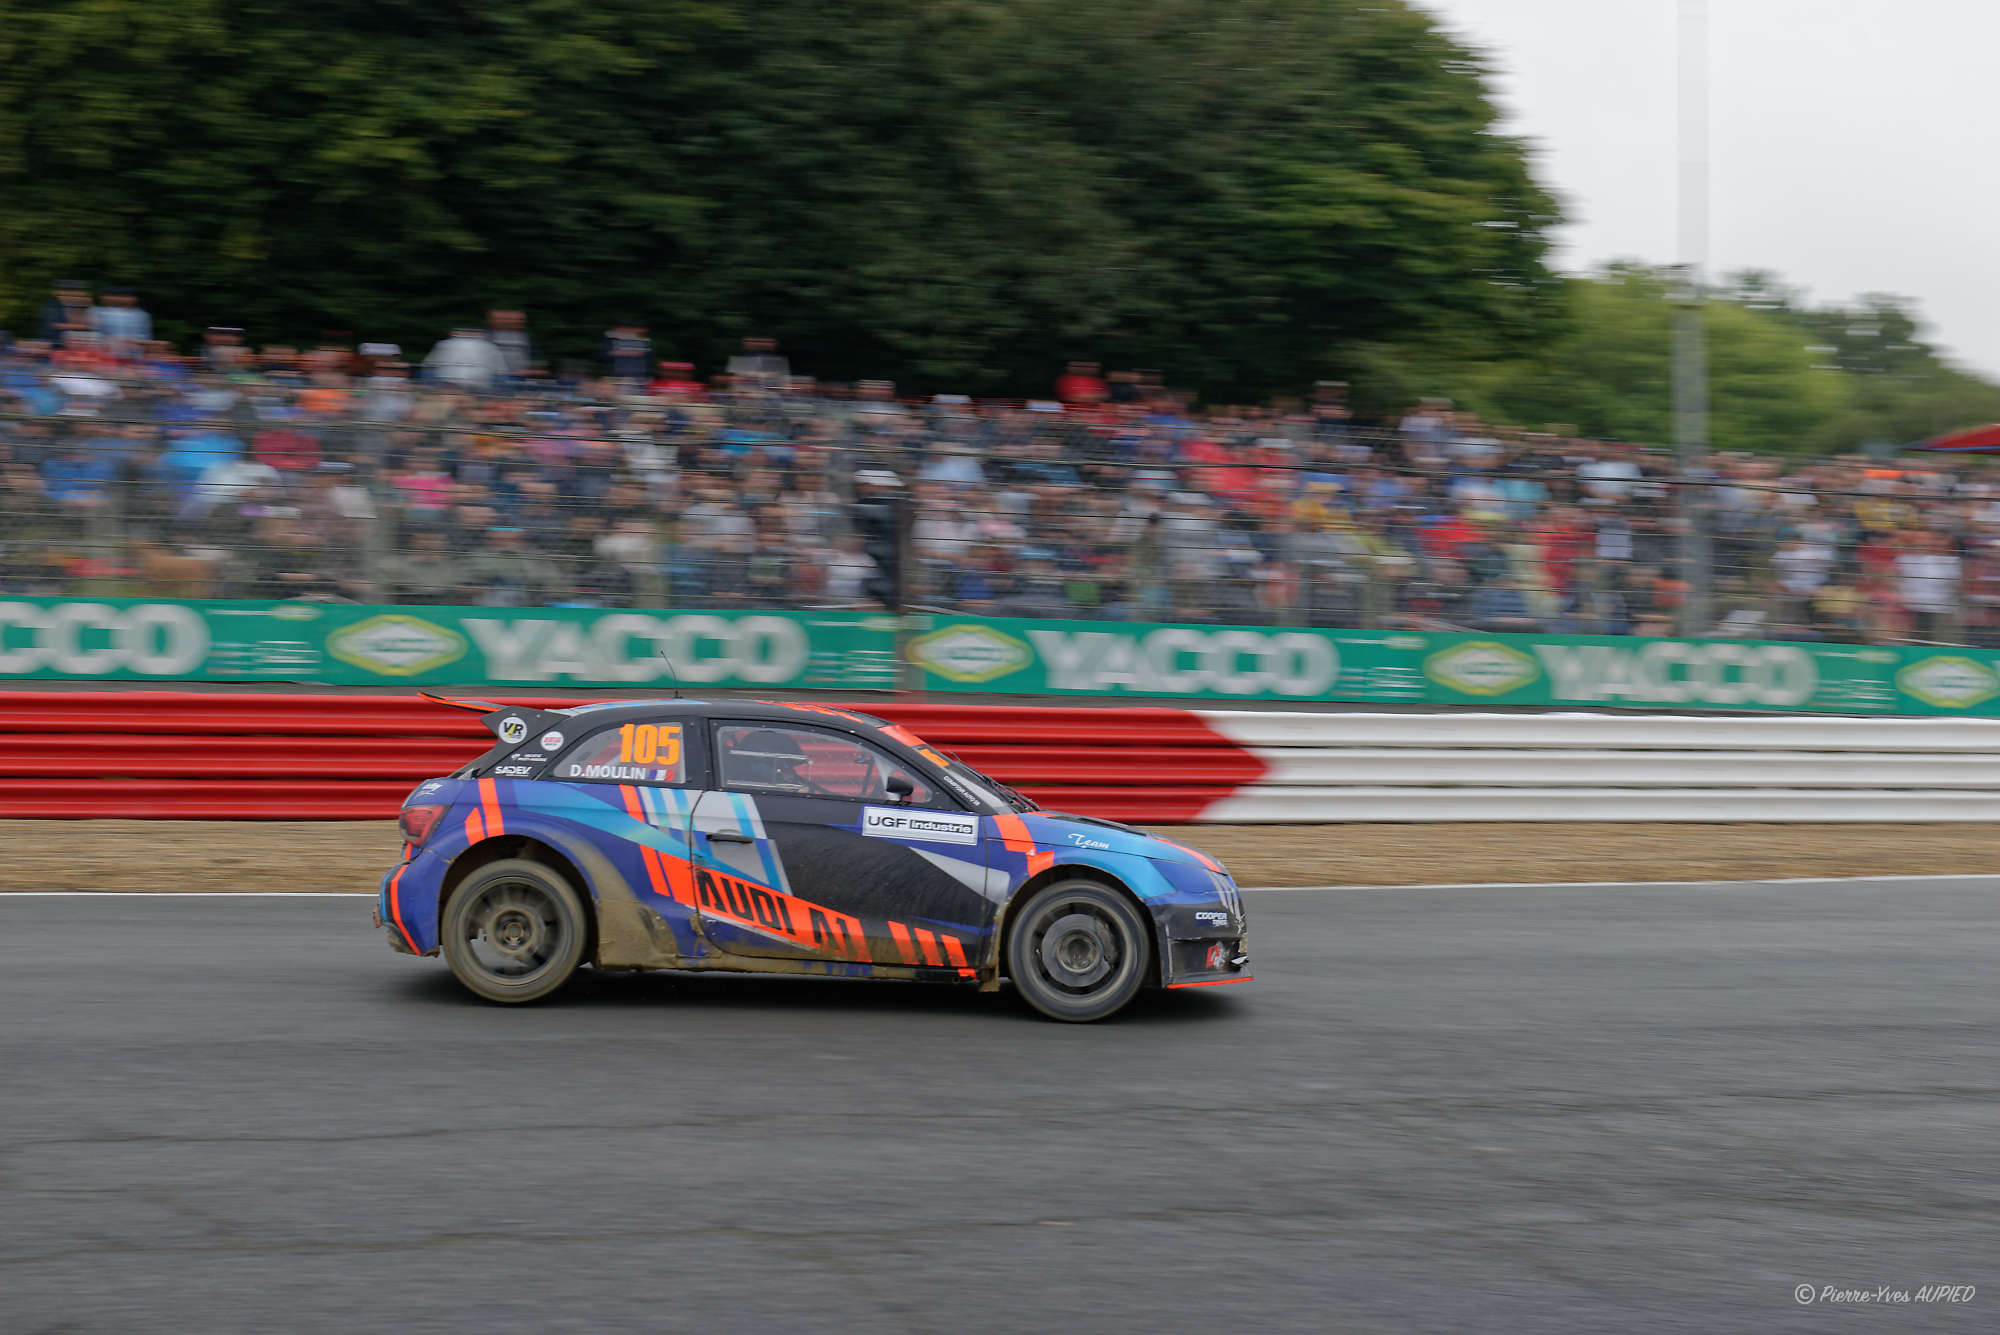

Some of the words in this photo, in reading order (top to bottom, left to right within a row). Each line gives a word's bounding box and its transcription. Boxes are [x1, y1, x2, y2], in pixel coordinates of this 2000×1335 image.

[459, 613, 810, 683] YACCO
[1025, 628, 1340, 697] YACCO
[1533, 641, 1817, 705] YACCO
[619, 723, 681, 765] 105
[495, 766, 532, 775] SADEV
[570, 764, 647, 780] D.MOULIN
[868, 815, 908, 828] UGF
[696, 869, 796, 936] AUDI
[808, 907, 862, 959] A1
[1195, 911, 1228, 920] COOPER
